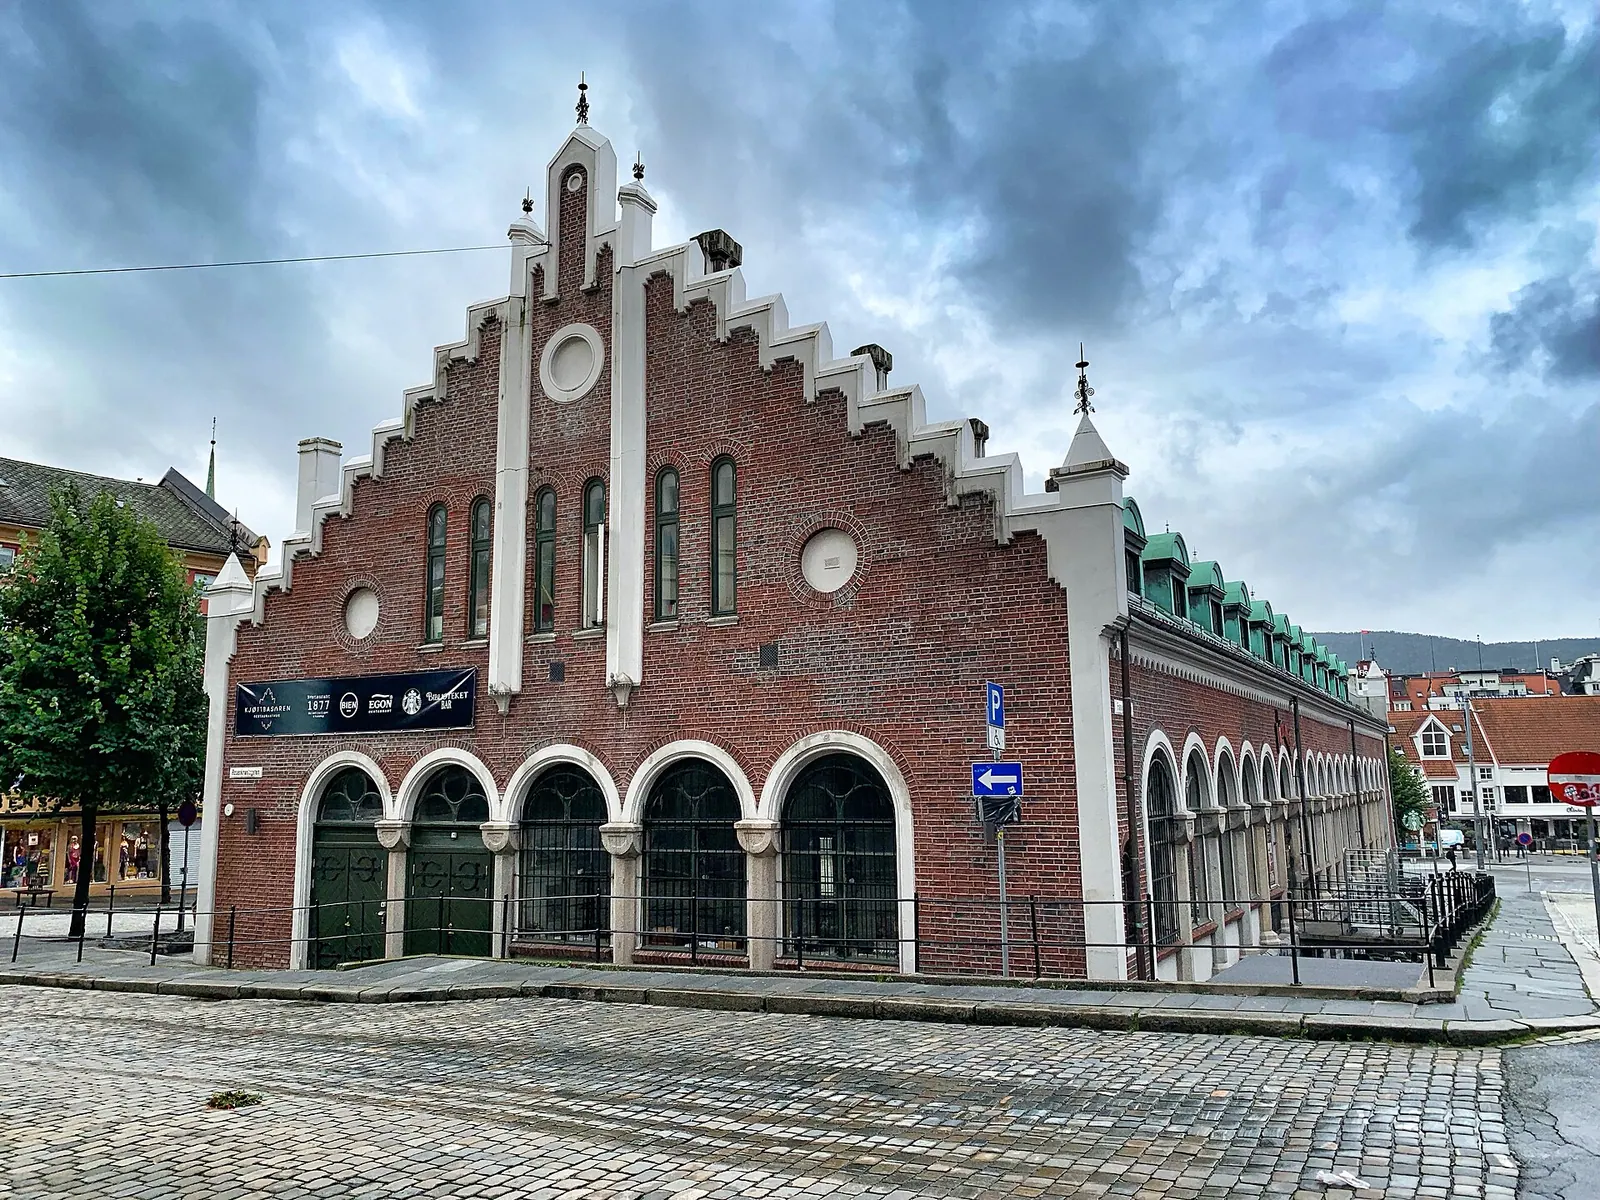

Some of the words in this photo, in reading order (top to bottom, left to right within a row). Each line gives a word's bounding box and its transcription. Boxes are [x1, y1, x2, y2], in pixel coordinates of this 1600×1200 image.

[307, 700, 330, 711] 1877
[341, 701, 357, 709] BIEN
[368, 699, 392, 709] EGON
[440, 699, 453, 710] BAR
[991, 689, 1000, 721] P
